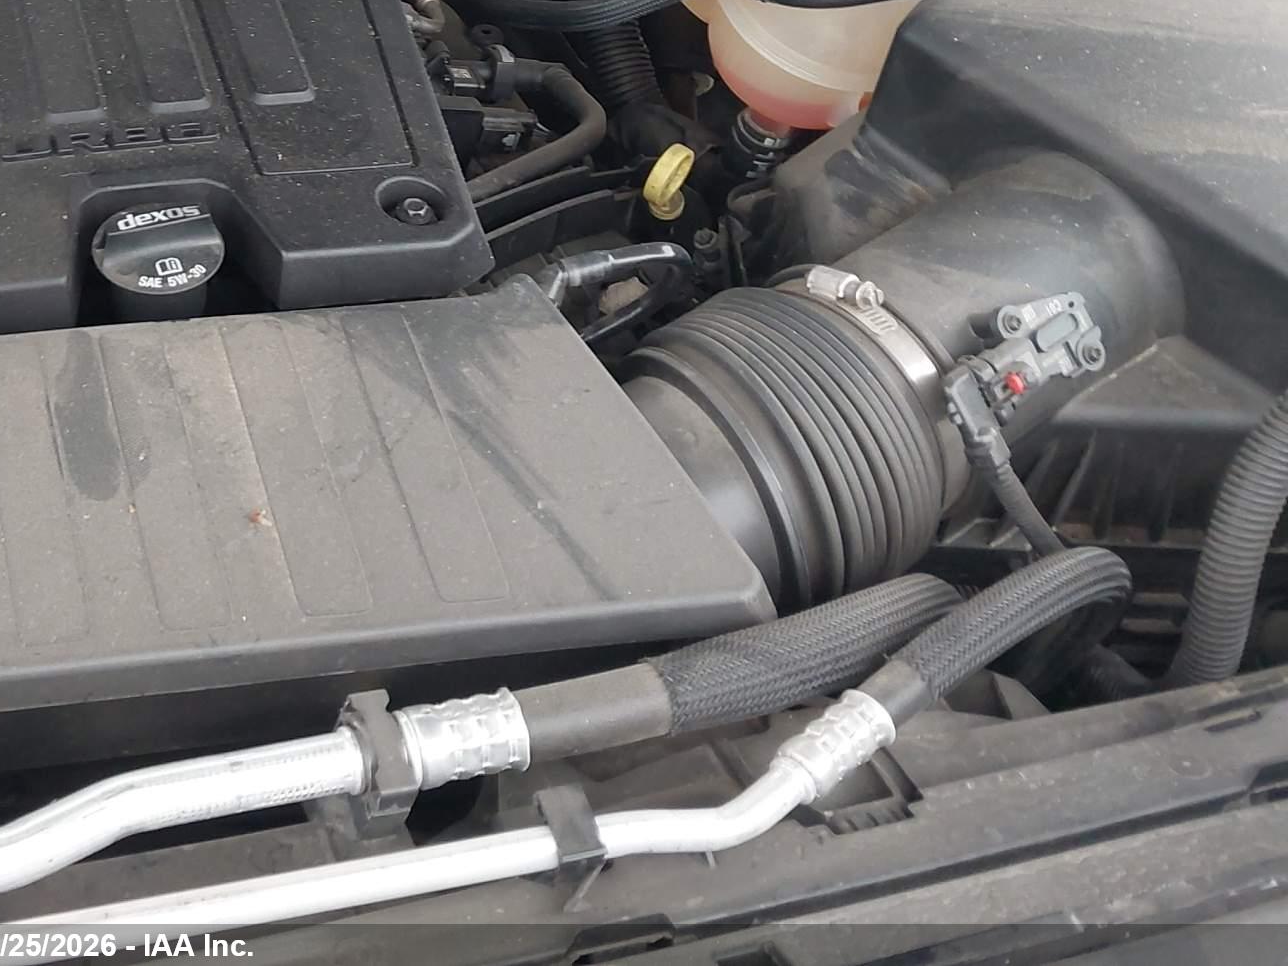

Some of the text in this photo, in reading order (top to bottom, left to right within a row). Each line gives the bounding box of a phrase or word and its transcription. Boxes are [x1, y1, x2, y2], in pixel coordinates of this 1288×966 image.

[116, 205, 201, 231] dexos
[138, 263, 207, 288] SAE 5W-30
